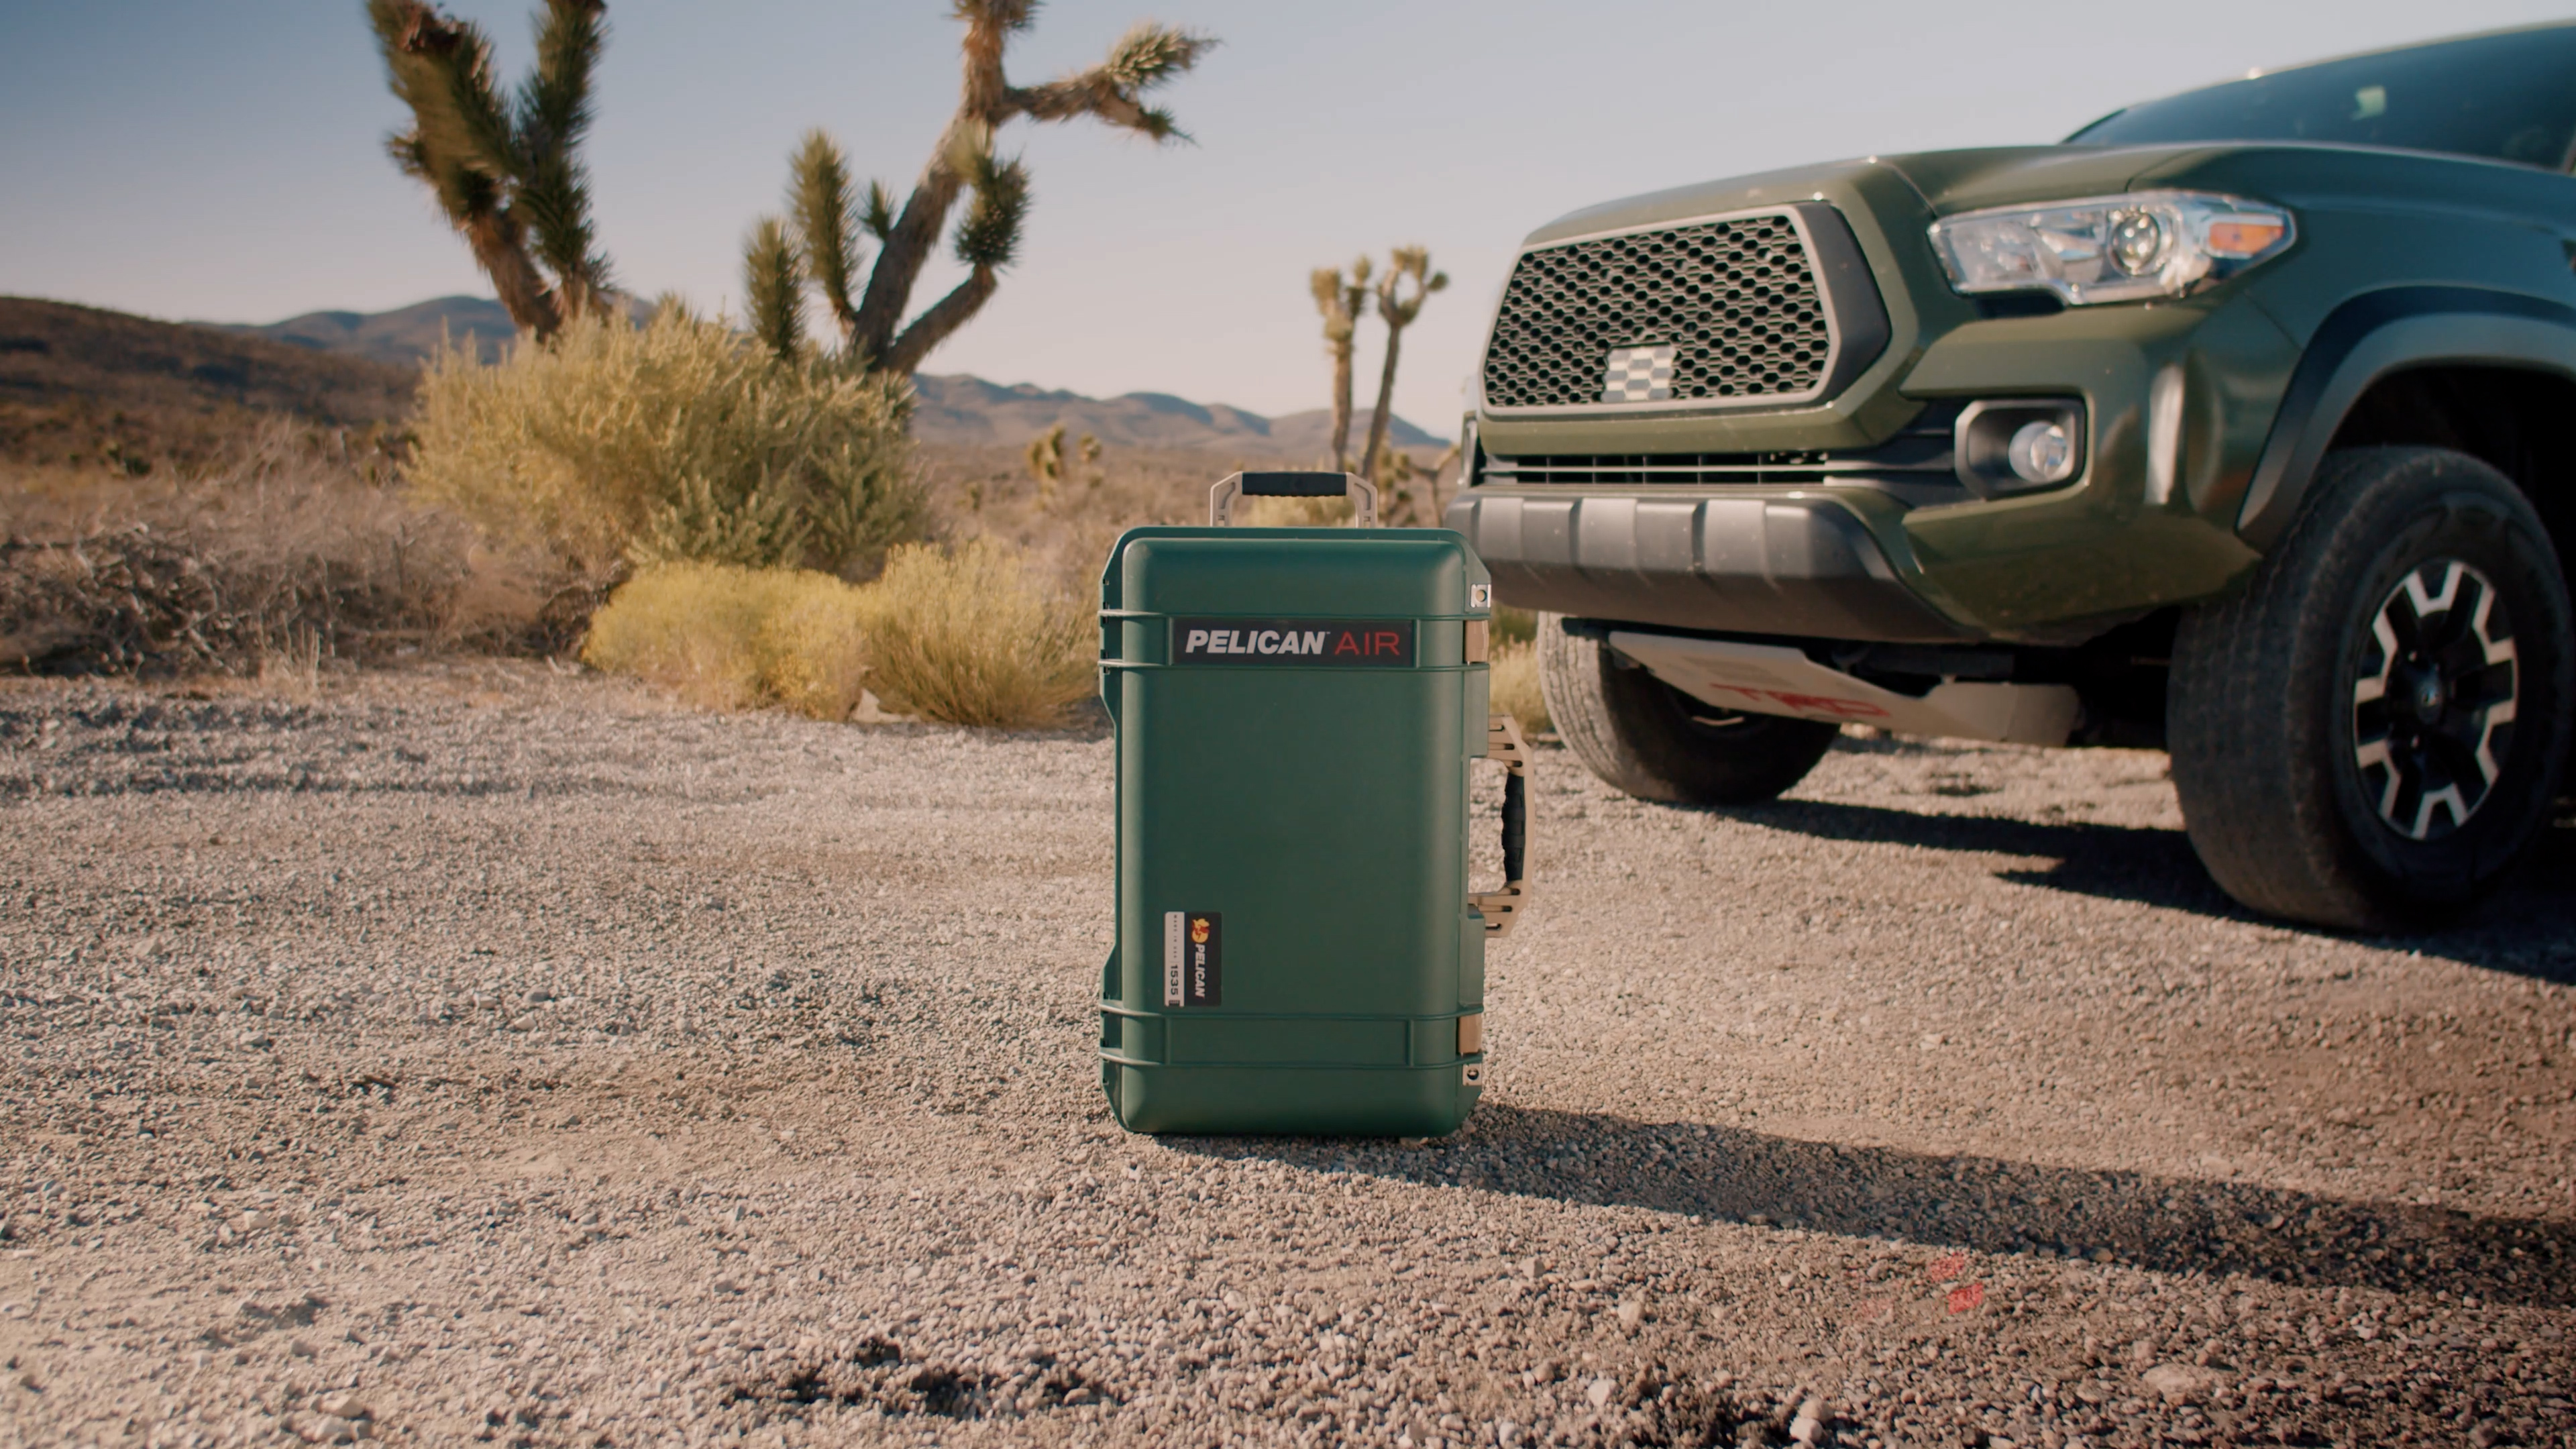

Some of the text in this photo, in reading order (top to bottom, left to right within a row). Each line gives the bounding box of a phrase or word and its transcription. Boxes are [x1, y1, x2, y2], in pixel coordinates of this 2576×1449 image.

[1185, 629, 1401, 655] PELICAN AIR
[1171, 964, 1179, 996] 1535
[1195, 943, 1205, 998] PELICAN
